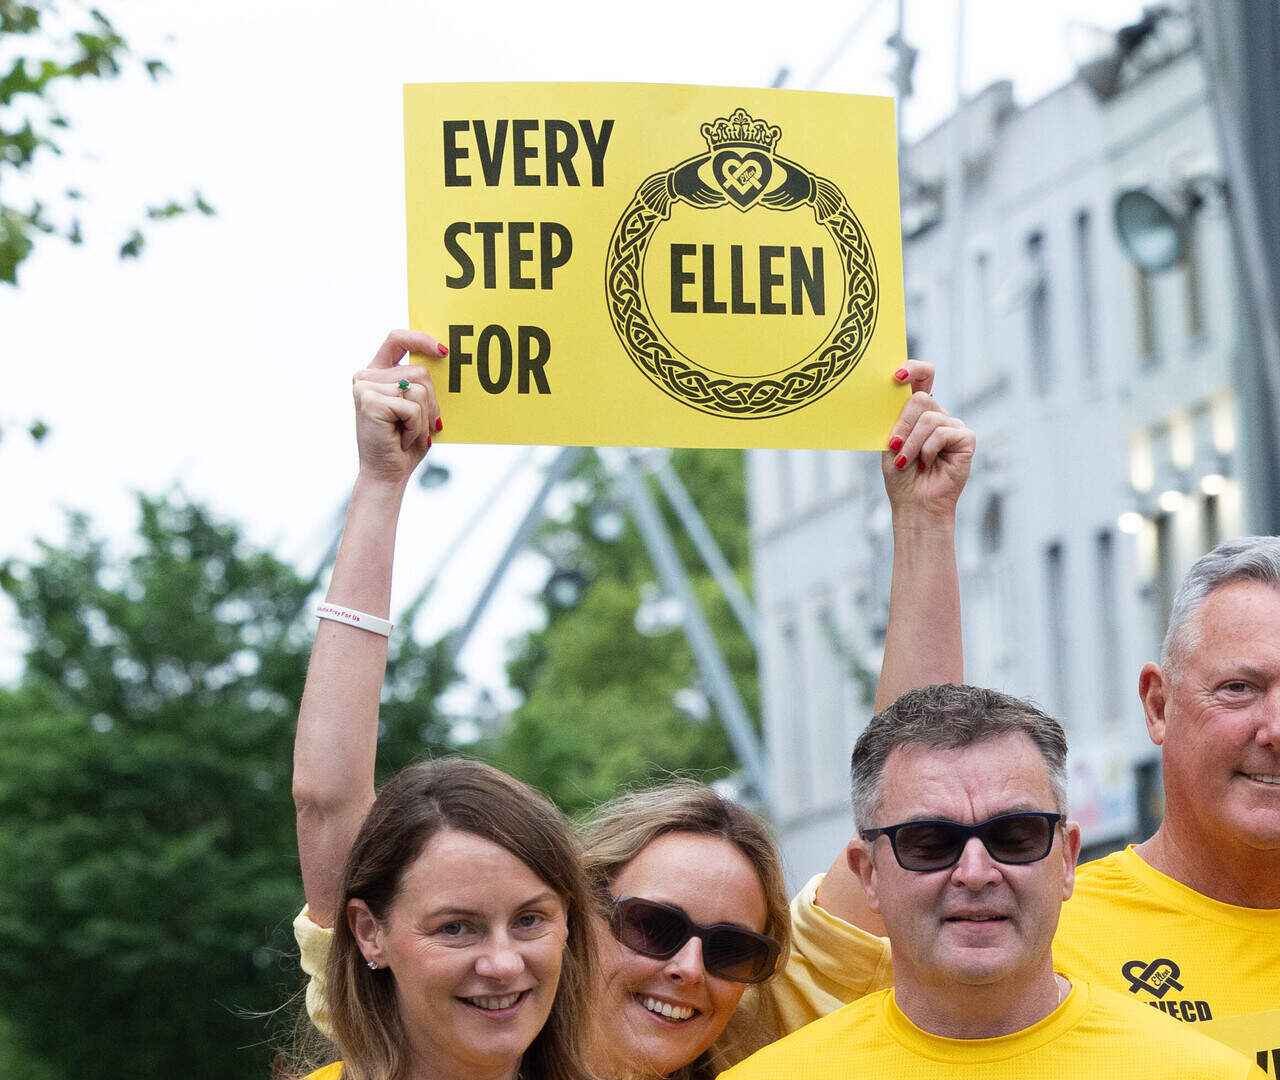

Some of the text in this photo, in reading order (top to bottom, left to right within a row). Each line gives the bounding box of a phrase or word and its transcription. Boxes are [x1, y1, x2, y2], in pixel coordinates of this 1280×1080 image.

[443, 120, 615, 187] EVERY
[444, 222, 572, 290] STEP
[671, 244, 825, 315] ELLEN
[449, 325, 551, 394] FOR
[1143, 1000, 1213, 1022] ECD
